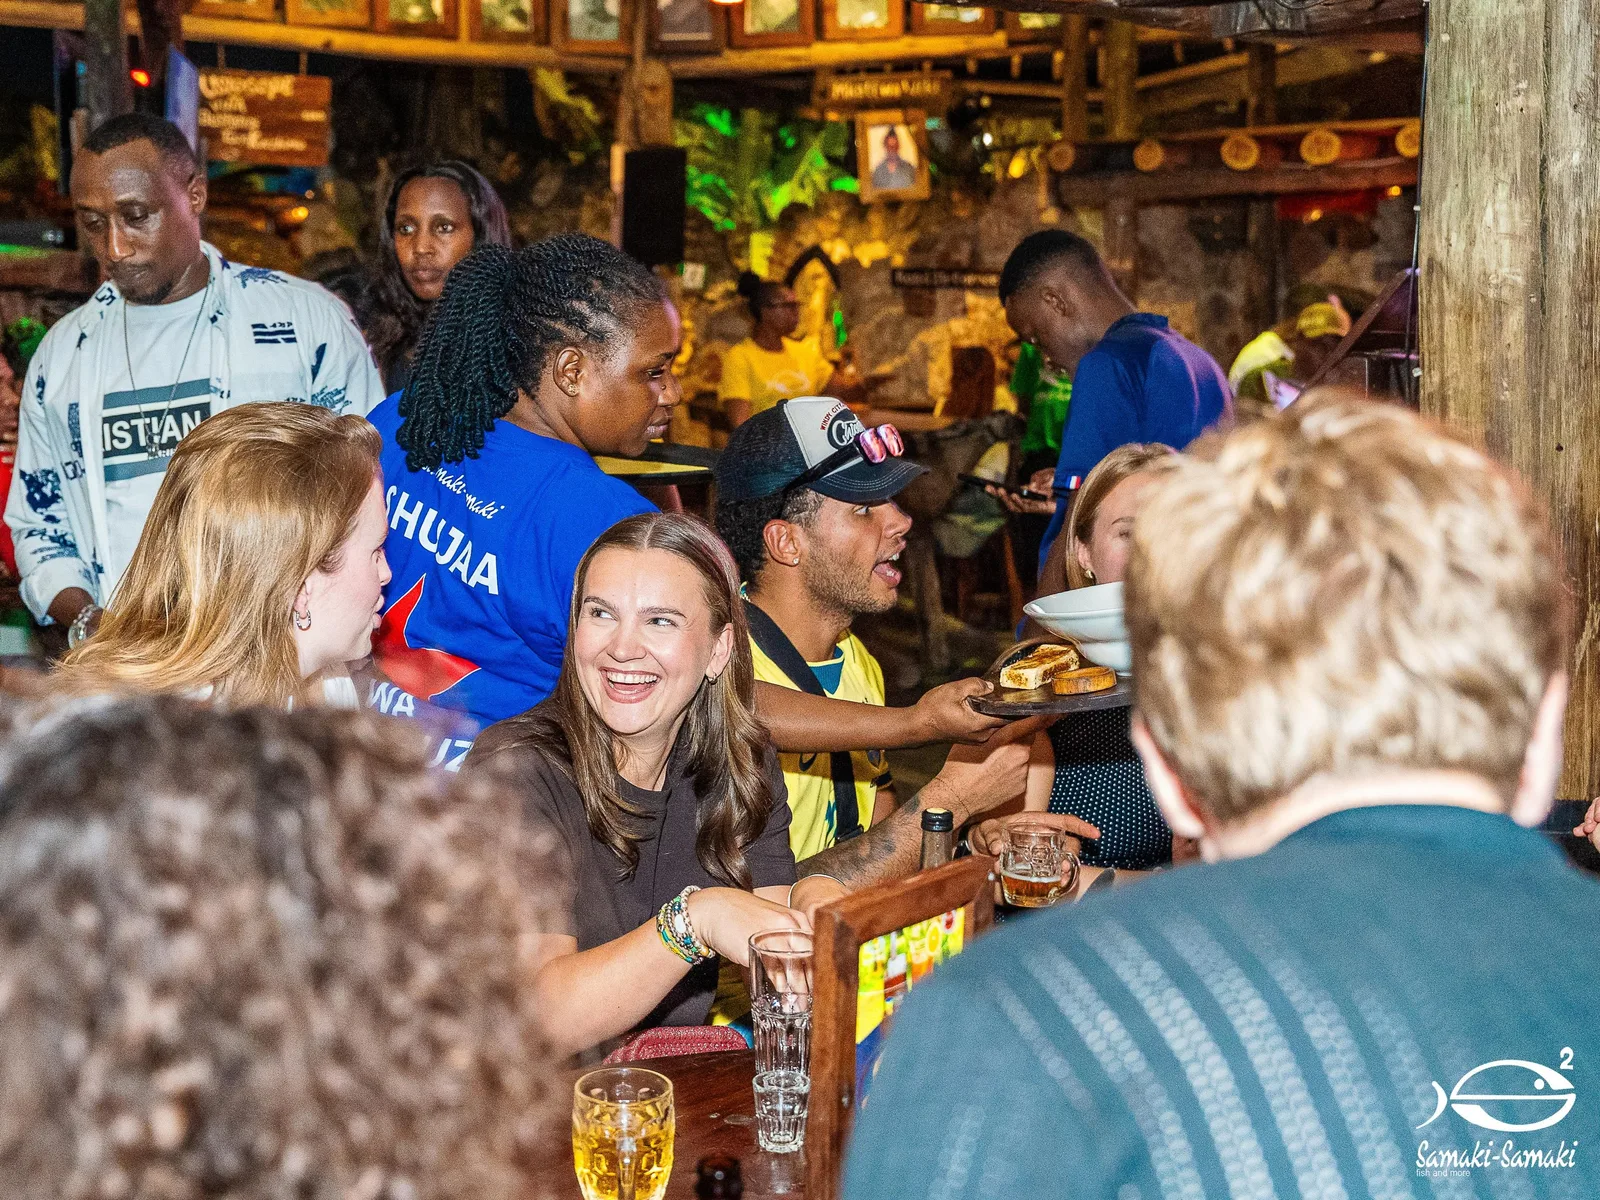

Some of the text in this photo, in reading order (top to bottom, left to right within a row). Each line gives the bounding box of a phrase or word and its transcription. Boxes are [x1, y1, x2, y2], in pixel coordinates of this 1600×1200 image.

[103, 410, 200, 451] ISTIAN
[820, 411, 832, 430] WINDY
[386, 485, 499, 595] SHUJAA
